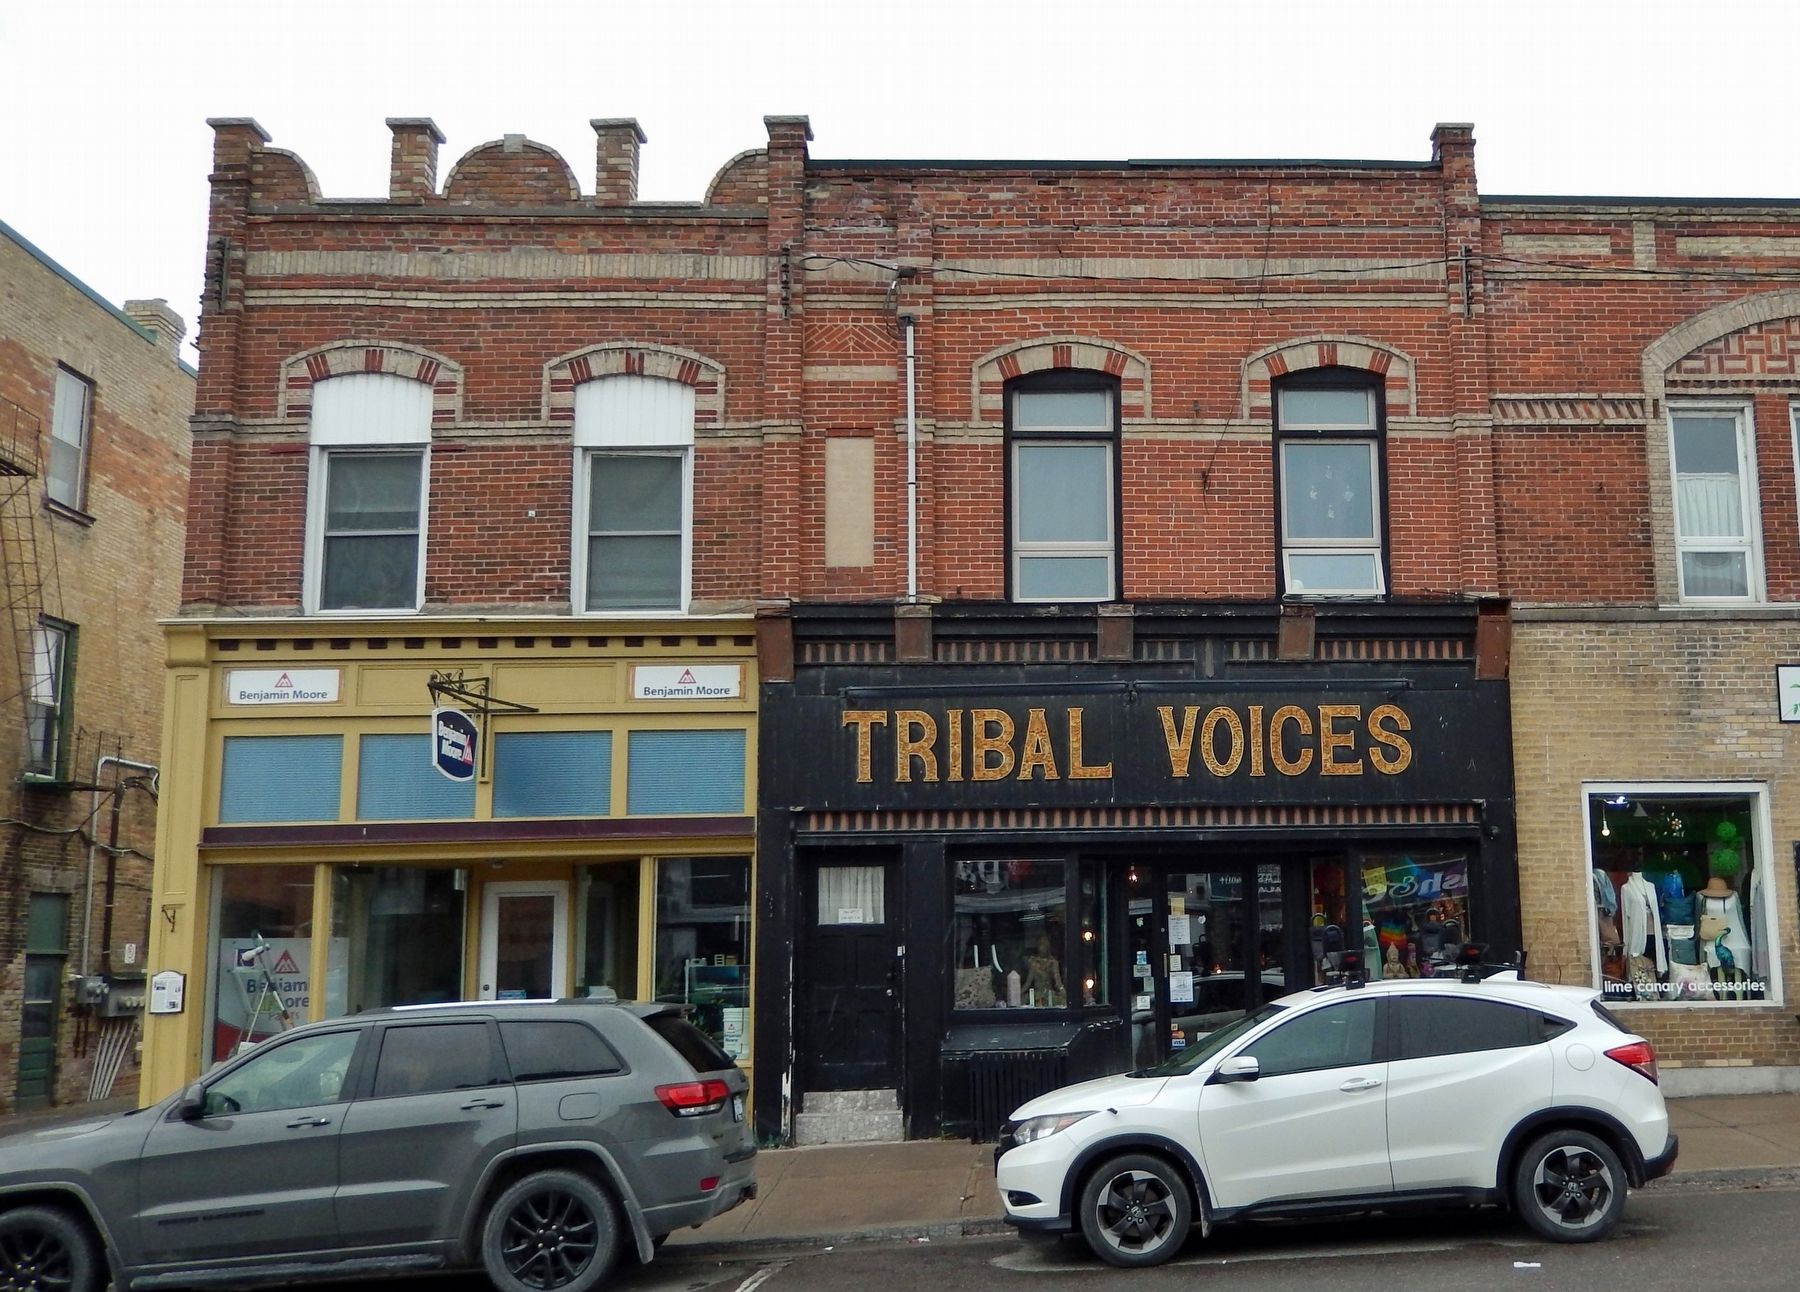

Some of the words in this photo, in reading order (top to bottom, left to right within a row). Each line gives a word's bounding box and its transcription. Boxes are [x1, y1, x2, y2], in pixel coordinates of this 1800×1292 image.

[239, 690, 289, 702] Benjamin
[293, 690, 328, 700] Moore
[643, 686, 693, 698] Benjamin
[696, 686, 730, 696] Moore
[439, 720, 467, 747] Benjamin
[441, 739, 463, 761] Moore
[842, 707, 1113, 783] TRIBAL
[1157, 704, 1412, 777] VOICES
[1603, 980, 1633, 993] lime
[1636, 981, 1683, 995] canary
[1688, 979, 1766, 992] accessories
